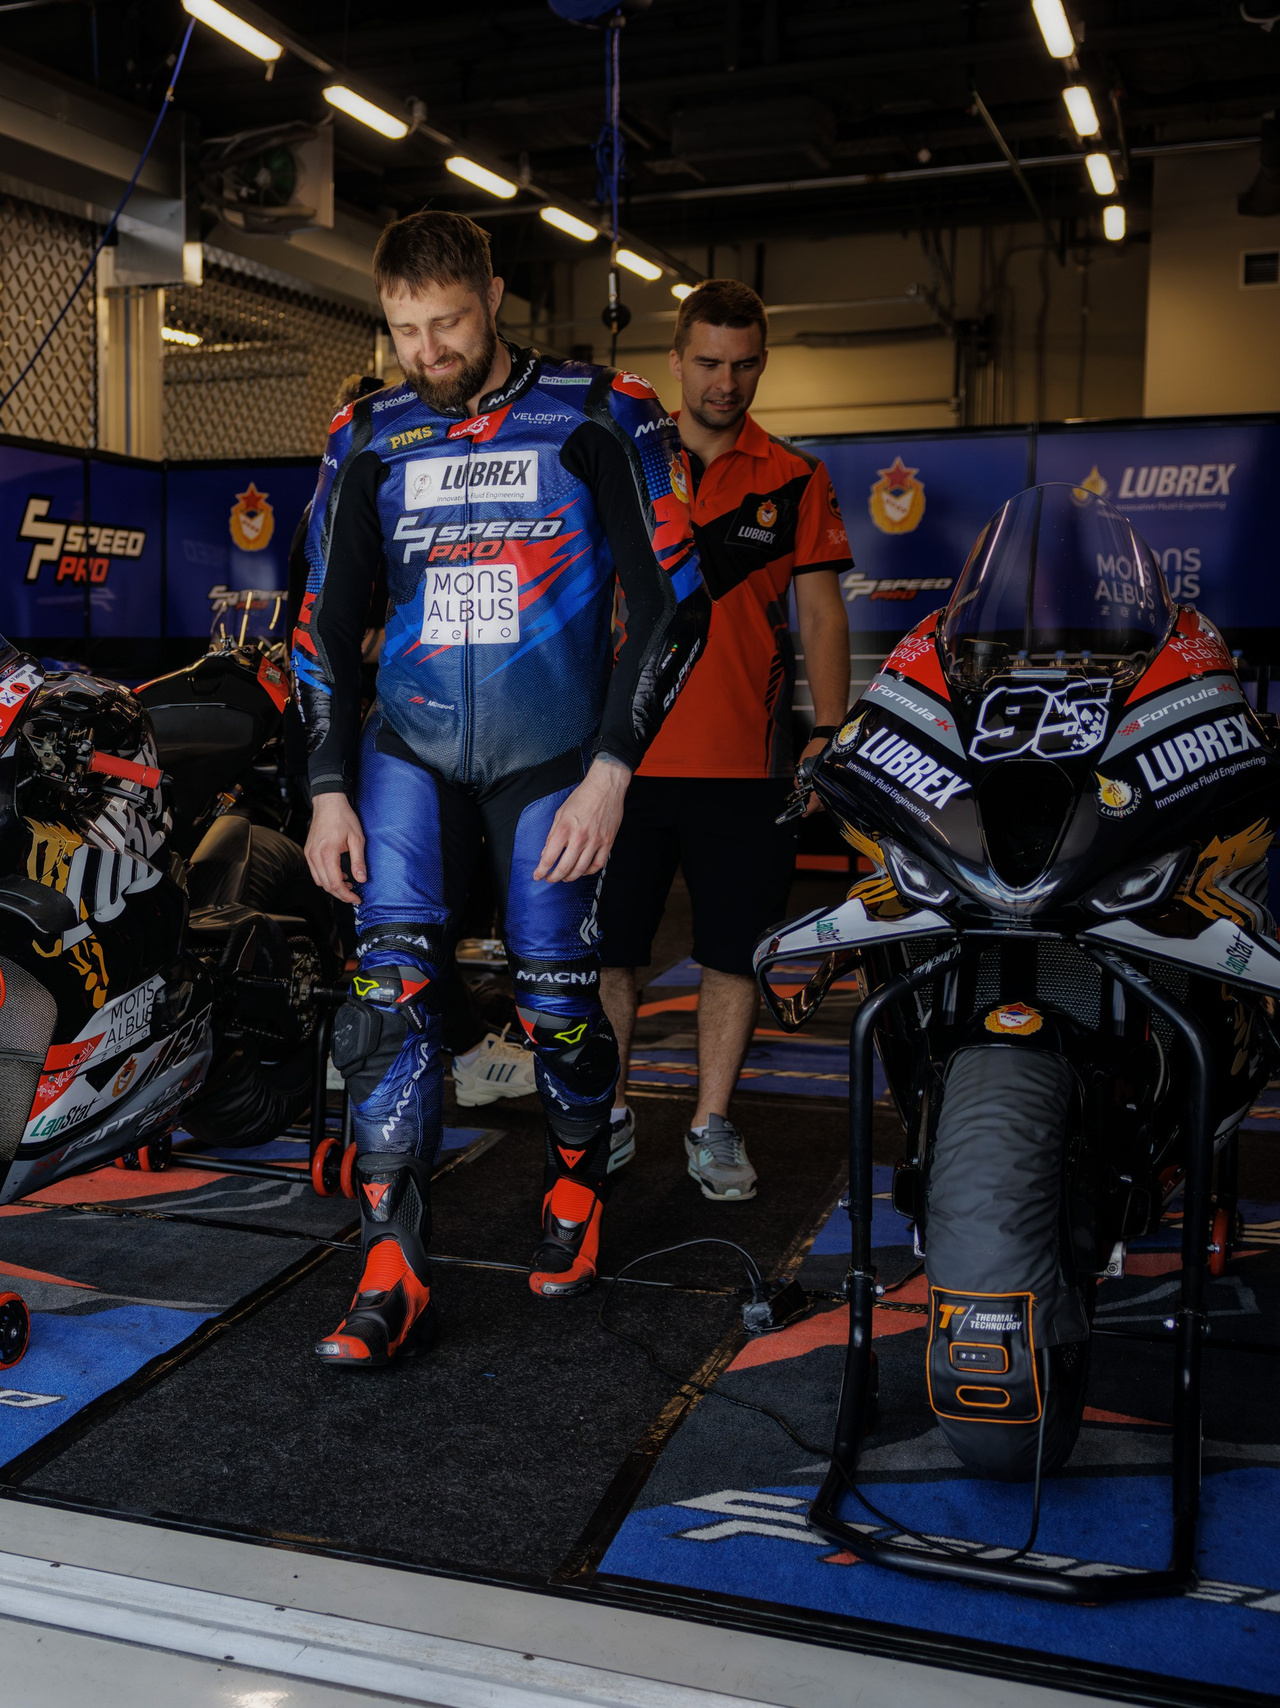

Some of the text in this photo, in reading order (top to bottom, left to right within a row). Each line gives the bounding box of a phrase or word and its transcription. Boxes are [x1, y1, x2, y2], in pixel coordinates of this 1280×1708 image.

[487, 359, 537, 407] MACNA
[512, 411, 573, 423] VELOCITY
[389, 426, 434, 450] PIMS
[440, 459, 532, 491] LUBREX
[1117, 463, 1237, 499] LUBREX
[470, 492, 485, 500] Fluid
[485, 491, 525, 501] Engineering
[63, 524, 146, 558] SPEED
[435, 519, 563, 543] SPEED
[737, 525, 777, 545] LUBREX
[427, 540, 503, 562] PRO
[56, 555, 110, 583] PRO
[433, 570, 514, 596] MONS
[876, 577, 953, 590] SPEED
[427, 597, 514, 622] ALBUS
[1138, 683, 1235, 727] Formula-K
[1135, 713, 1262, 793] LUBREX
[855, 727, 973, 811] LUBREX
[846, 759, 932, 823] Innovative Fluid Engineering
[1154, 755, 1267, 810] Innovative Fluid Engineering
[516, 970, 598, 985] MACNA
[970, 1320, 1023, 1331] TECHNOLOGY
[975, 1312, 1014, 1323] THERMAL
